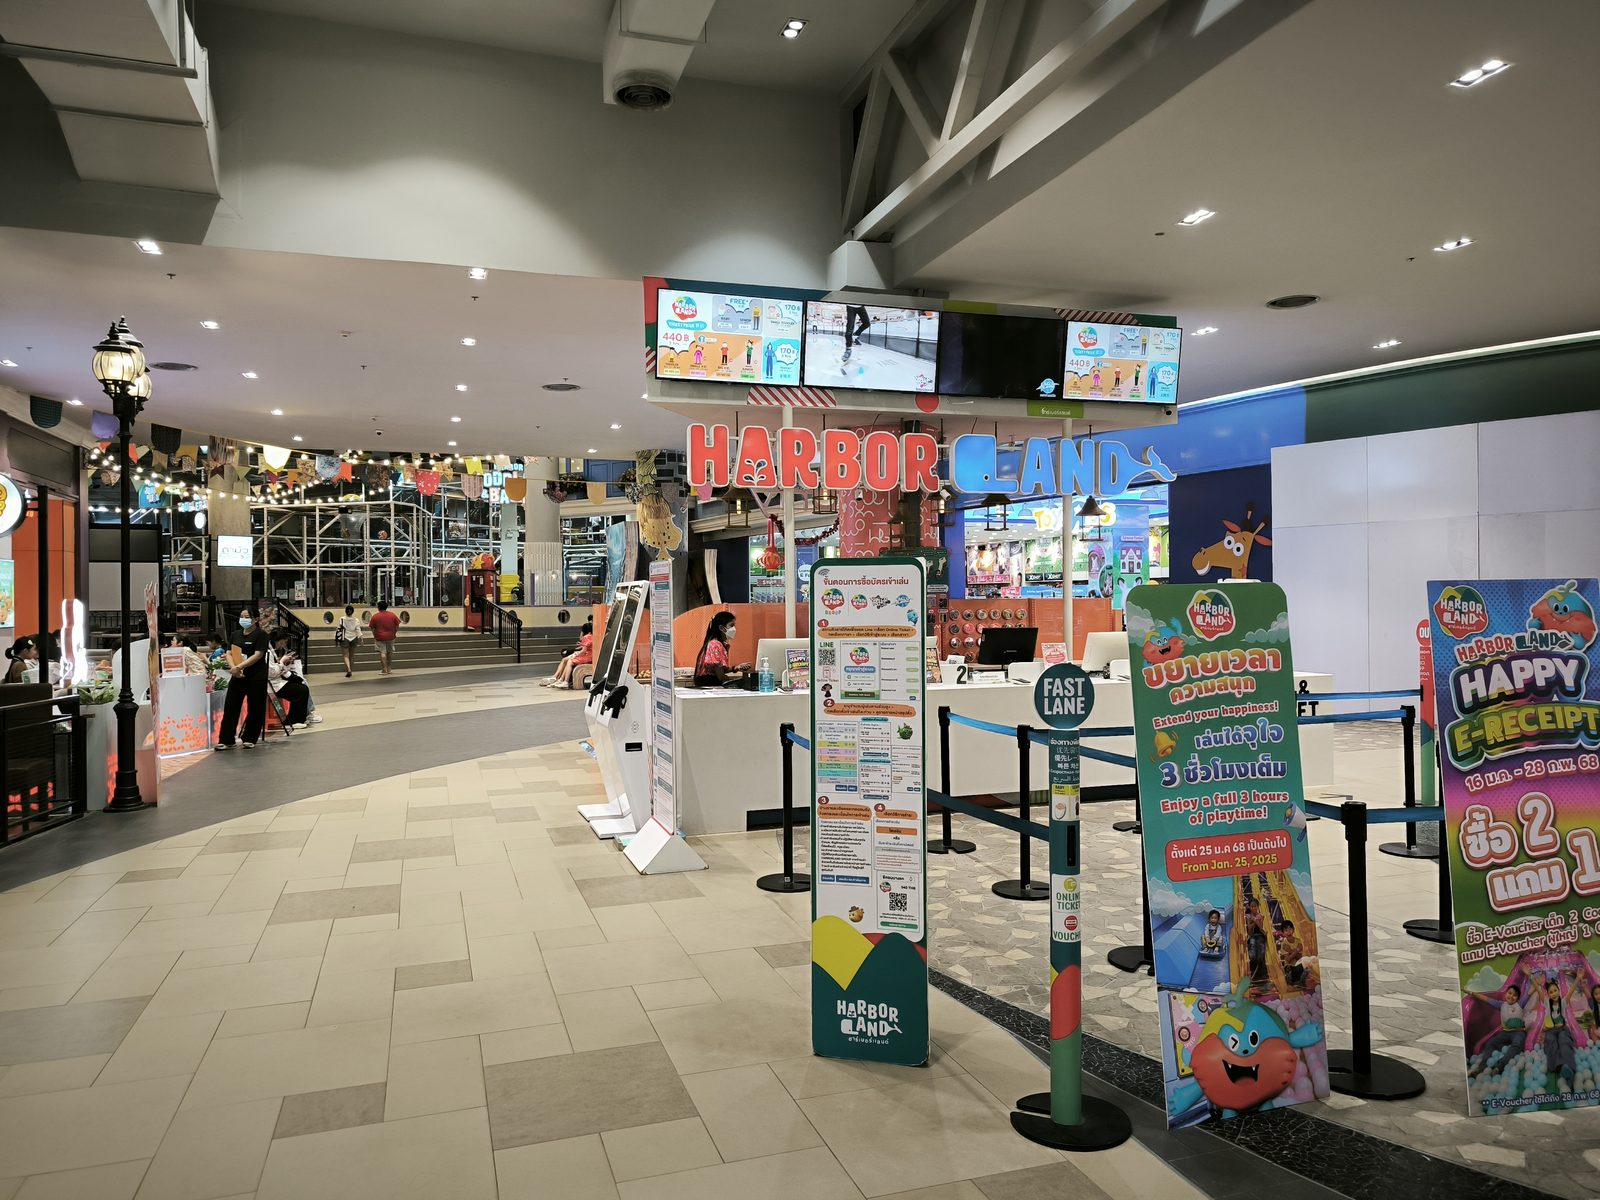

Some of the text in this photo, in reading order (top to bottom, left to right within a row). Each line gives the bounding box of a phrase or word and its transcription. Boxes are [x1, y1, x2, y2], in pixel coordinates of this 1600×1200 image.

[686, 422, 1177, 496] HARBOR LAND
[1193, 602, 1230, 616] HARBOR
[1440, 598, 1483, 614] HARBOR
[1195, 613, 1232, 626] LAND
[1443, 611, 1485, 625] LAND
[1456, 630, 1572, 662] HARBOR LAND
[956, 665, 967, 685] 2
[1143, 648, 1282, 688] ขยายเวลา
[1043, 677, 1086, 697] FAST
[1169, 675, 1256, 704] ความสนุก
[1298, 680, 1310, 694] &
[1459, 657, 1579, 708] HAPPY
[1043, 697, 1086, 715] LANE
[1153, 701, 1279, 728] Extend your happiness!
[1194, 717, 1284, 750] เล่นได้จุใจ
[1452, 704, 1600, 757] E-RECEIPT
[1159, 753, 1287, 787] 3 ชั่วโมงเต็ม
[1465, 774, 1484, 791] 16
[1485, 770, 1513, 788] ม.ค.
[1524, 760, 1545, 778] 28
[1547, 757, 1577, 774] ก.พ.
[1578, 754, 1599, 770] 68
[1161, 790, 1289, 813] Enjoy a full 3 hours
[1189, 806, 1268, 826] of playtime!
[1466, 797, 1555, 858] ซื้อ 2
[1171, 844, 1198, 859] ตั้งแต่
[1200, 845, 1212, 856] 25
[1232, 841, 1245, 853] 68
[1247, 836, 1287, 852] เป็นต้นไป
[1182, 853, 1278, 873] From Jan. 25, 2025
[1492, 835, 1600, 902] แถม 1
[1467, 927, 1483, 946] ซื้อ
[1484, 919, 1544, 941] E-Voucher
[1544, 912, 1565, 929] เด็ก
[1569, 910, 1578, 924] 2
[1486, 934, 1546, 958] E-Voucher
[1547, 925, 1578, 948] ผู้ใหญ่
[1582, 924, 1591, 937] 1
[836, 1000, 899, 1022] HARBOR
[840, 1017, 903, 1037] LAND
[1491, 1098, 1533, 1108] E-Voucher
[1562, 1093, 1572, 1101] 28
[1589, 1090, 1600, 1099] 68
